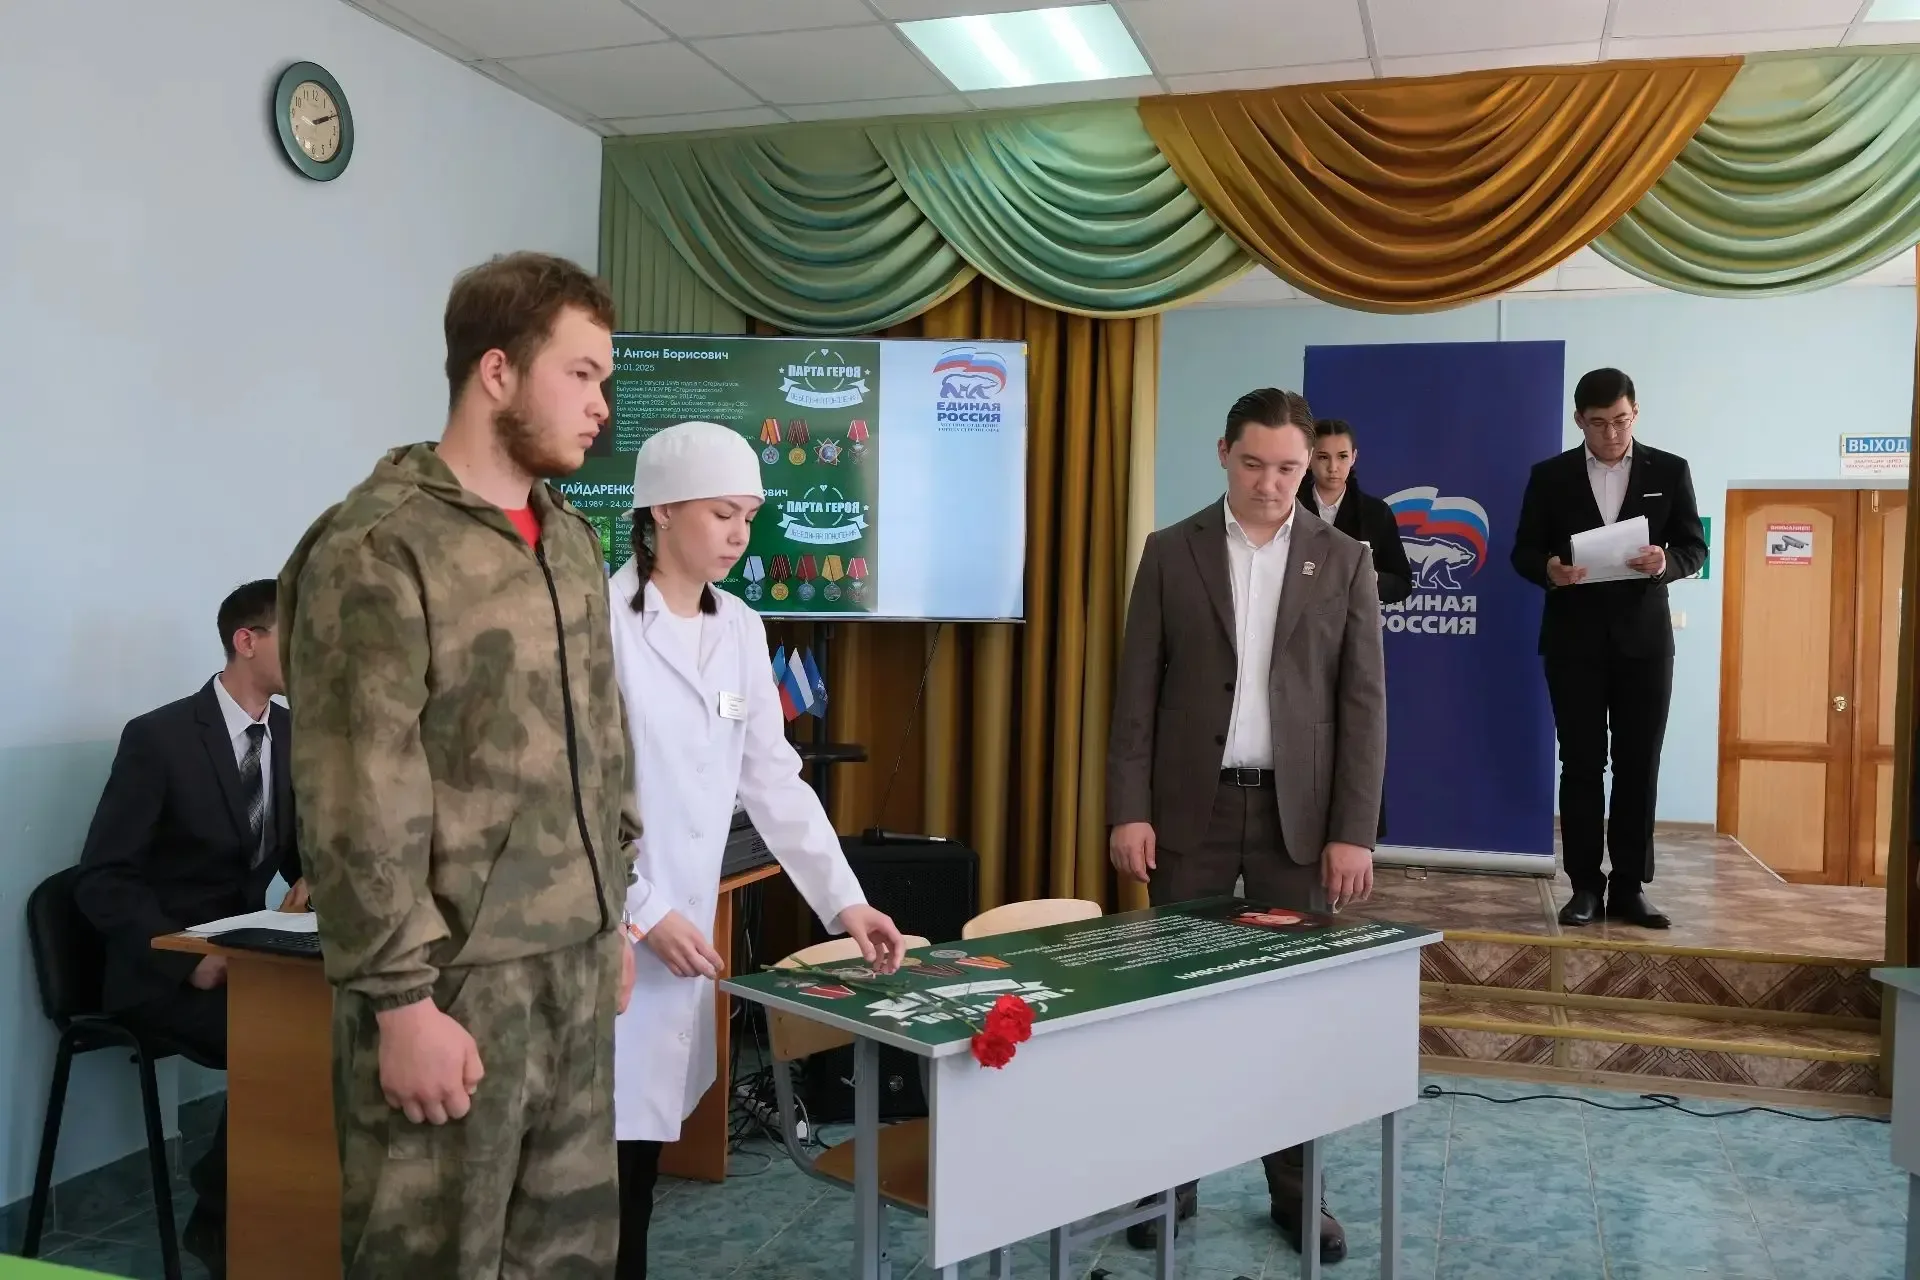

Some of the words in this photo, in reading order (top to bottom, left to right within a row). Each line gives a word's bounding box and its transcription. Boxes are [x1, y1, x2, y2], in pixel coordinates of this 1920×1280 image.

[623, 347, 660, 359] Антон
[662, 348, 729, 362] Борисович
[612, 363, 655, 372] 09.01.2025
[788, 364, 825, 377] ПАРТА
[826, 365, 861, 378] ГЕРОЯ
[937, 401, 1001, 412] ЕДИНАЯ
[937, 412, 1001, 423] РОССИЯ
[1848, 438, 1908, 453] ВЫХОД
[763, 488, 788, 497] ович
[610, 500, 633, 508] 24.06
[786, 500, 823, 513] ПАРТА
[825, 501, 860, 514] ГЕРОЯ
[1173, 955, 1283, 980] Борисович
